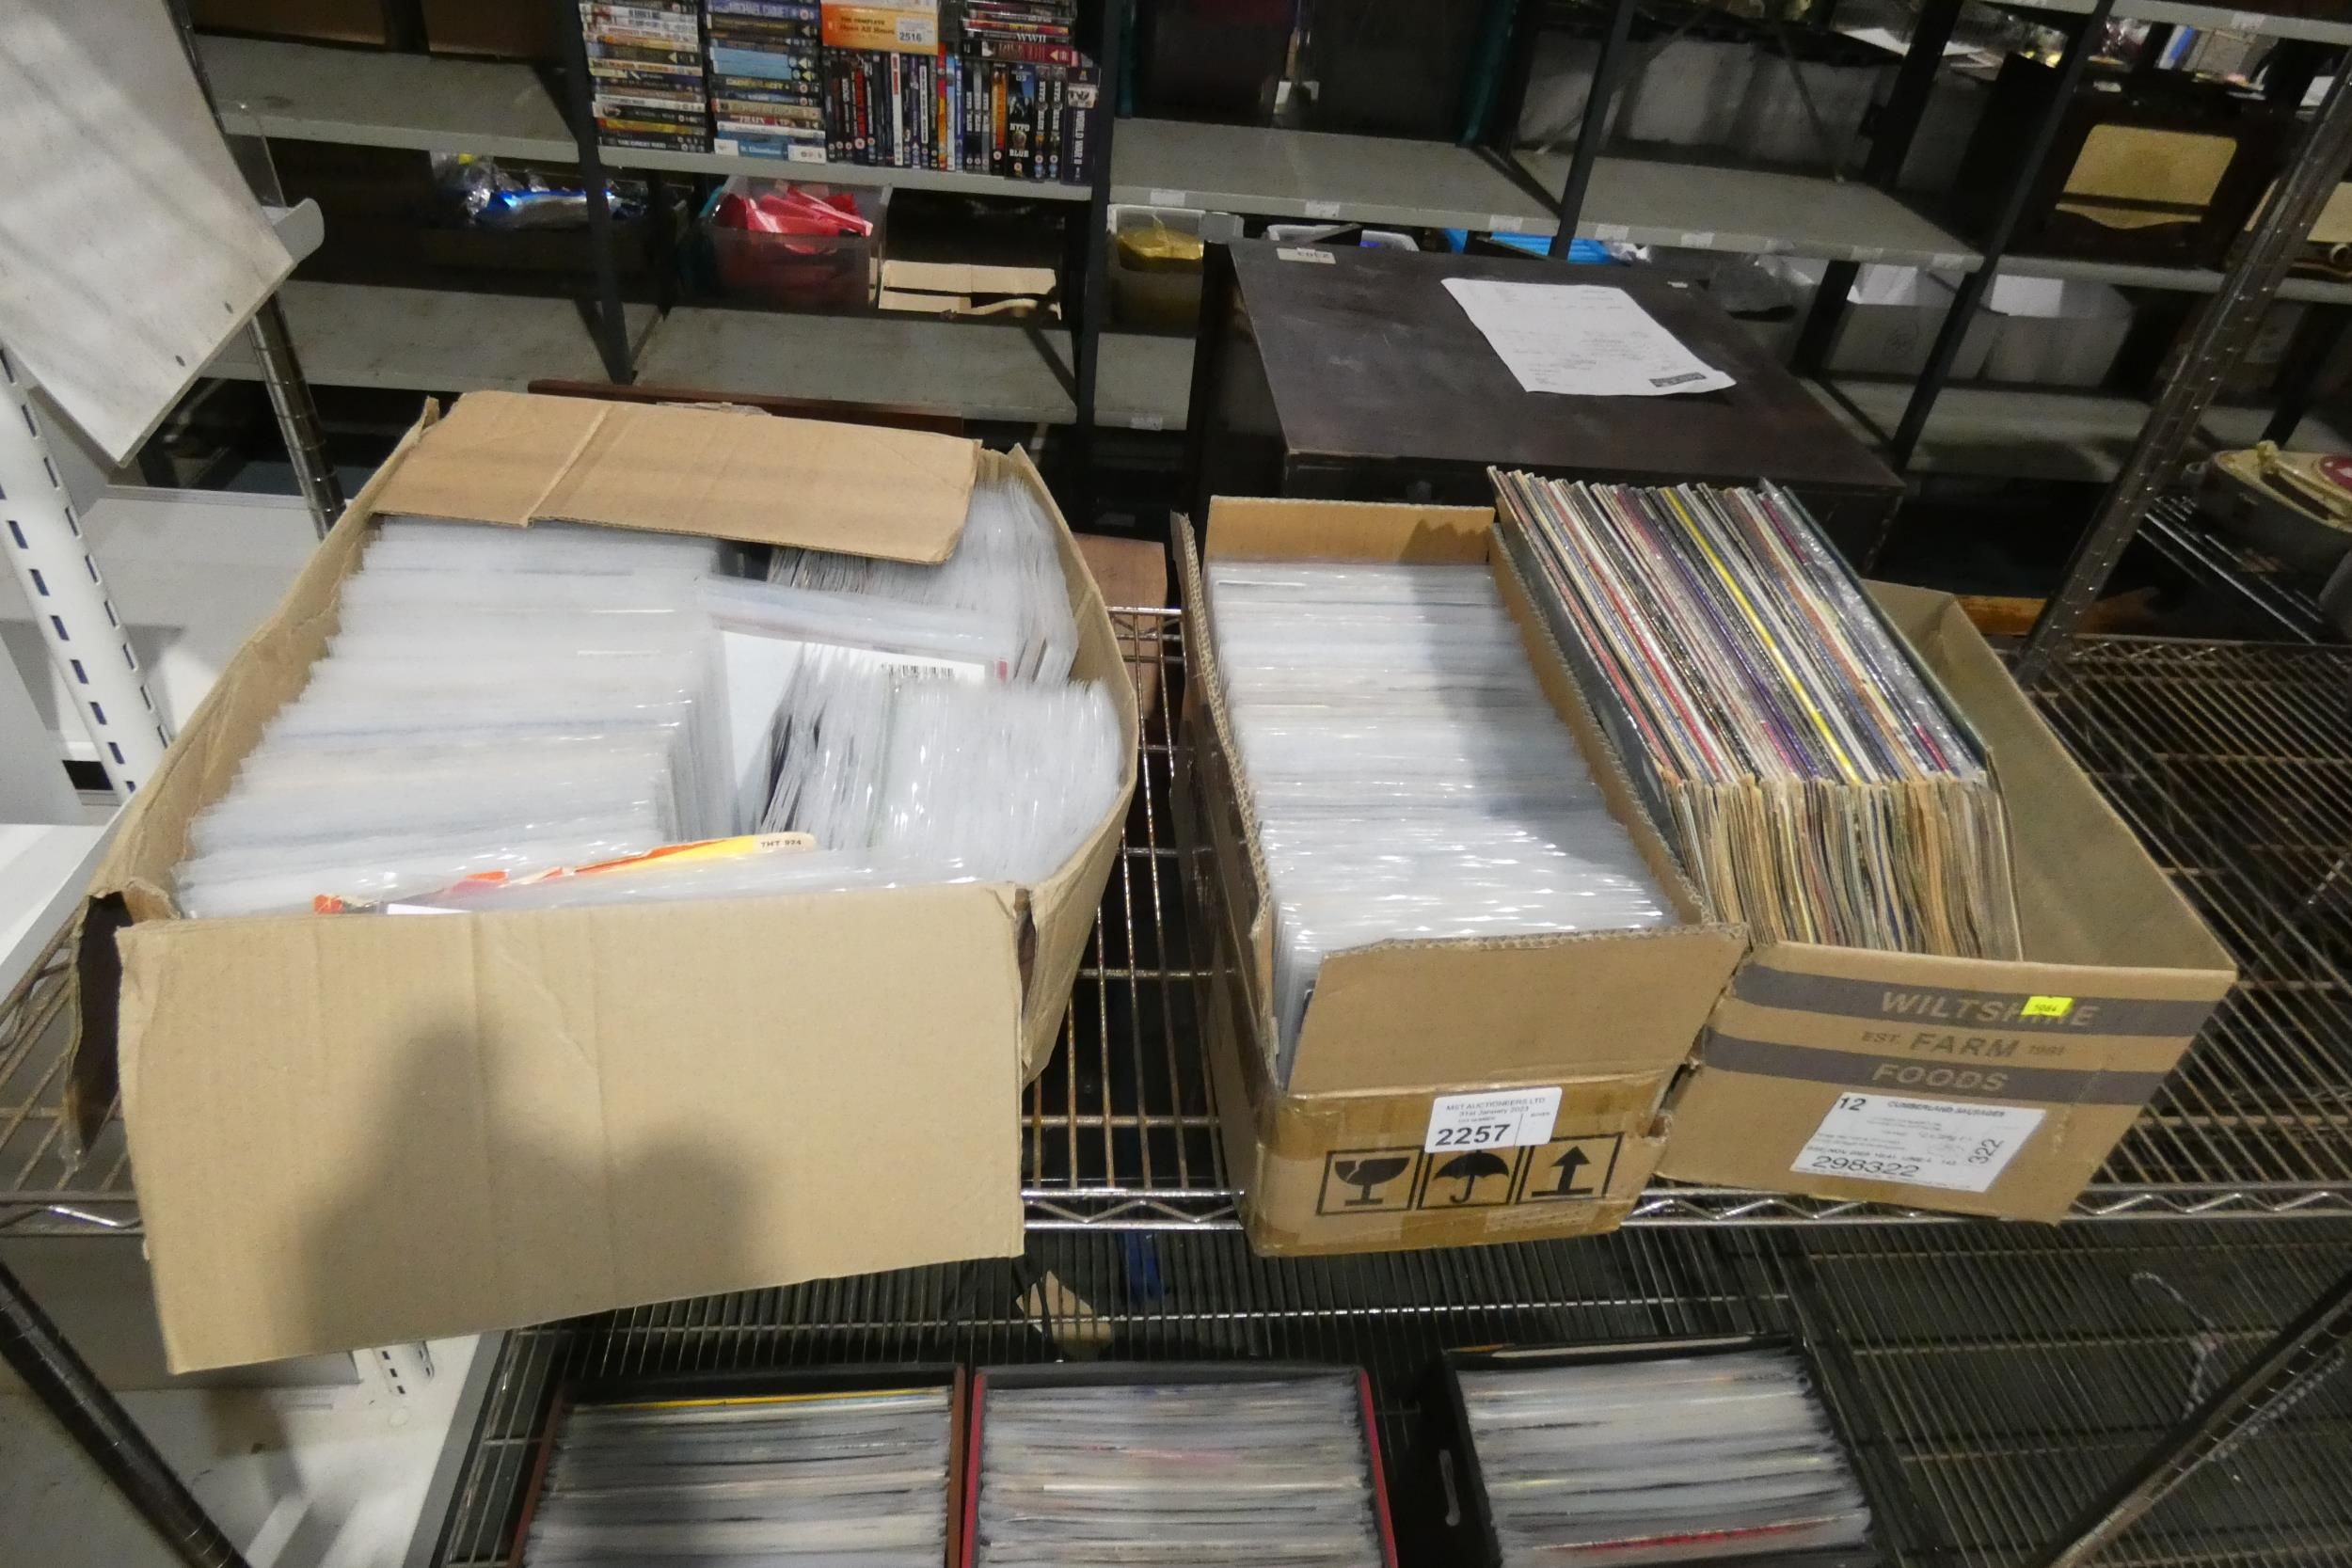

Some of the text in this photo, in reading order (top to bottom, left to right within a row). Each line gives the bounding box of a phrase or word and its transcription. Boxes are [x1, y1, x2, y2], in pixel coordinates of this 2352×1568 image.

[1075, 110, 1086, 139] WORLD
[1009, 149, 1029, 158] BLUE
[1074, 139, 1084, 159] WAR
[1910, 1033, 2021, 1057] FARM
[1872, 1063, 2010, 1092] FOODS
[1466, 1099, 1528, 1110] AUCTIONEERS
[1478, 1108, 1506, 1117] January
[1839, 1097, 2006, 1117] 12 CUMBERLAND SAUSAGES
[1435, 1124, 1511, 1147] 2257
[1968, 1138, 2005, 1165] 322
[1811, 1155, 1920, 1177] 298322
